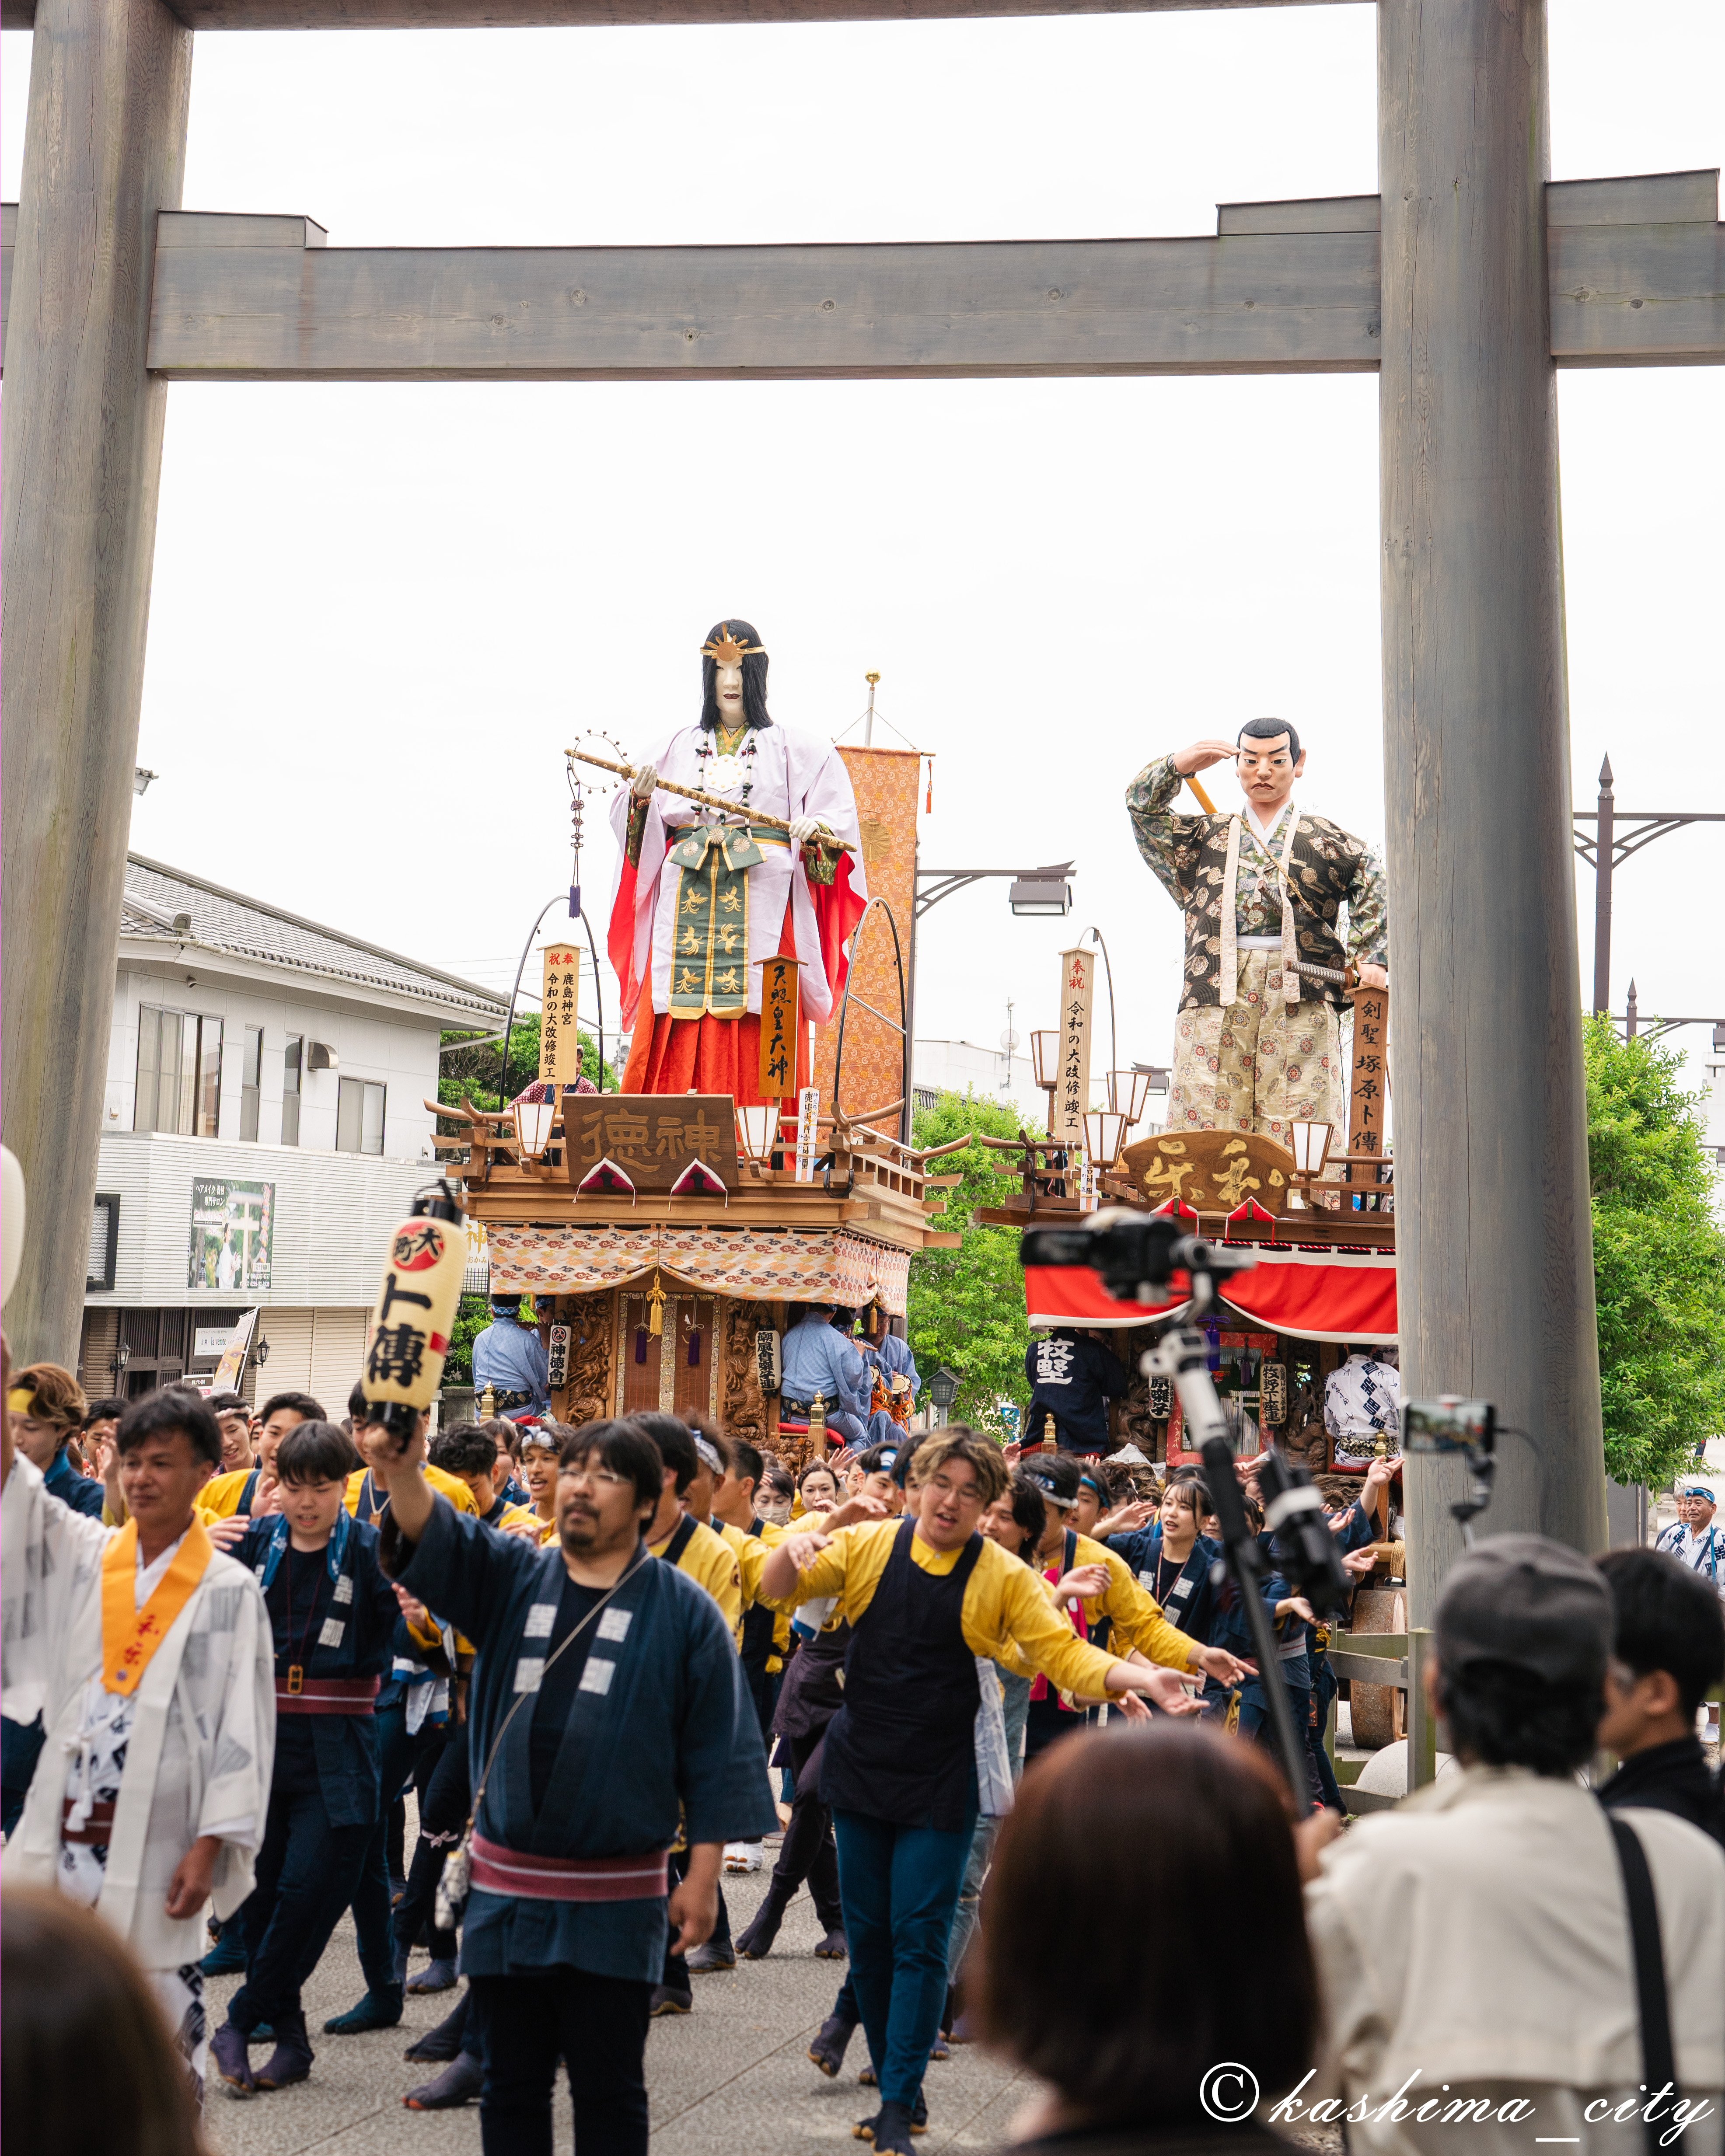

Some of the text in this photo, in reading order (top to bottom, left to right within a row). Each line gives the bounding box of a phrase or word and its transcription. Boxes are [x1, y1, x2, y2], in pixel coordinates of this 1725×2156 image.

[543, 972, 559, 1078] 令和の大改修竣工
[767, 964, 792, 1086] 天照皇大神
[1064, 958, 1086, 1129] 奉祝 令和の大改修竣工
[196, 1184, 216, 1194] ヘアメイク
[204, 1196, 224, 1207] 専門サロン
[1037, 1337, 1075, 1385] 牧野
[1151, 1375, 1170, 1416] 原囃子
[1262, 1365, 1281, 1422] 牧野下座連
